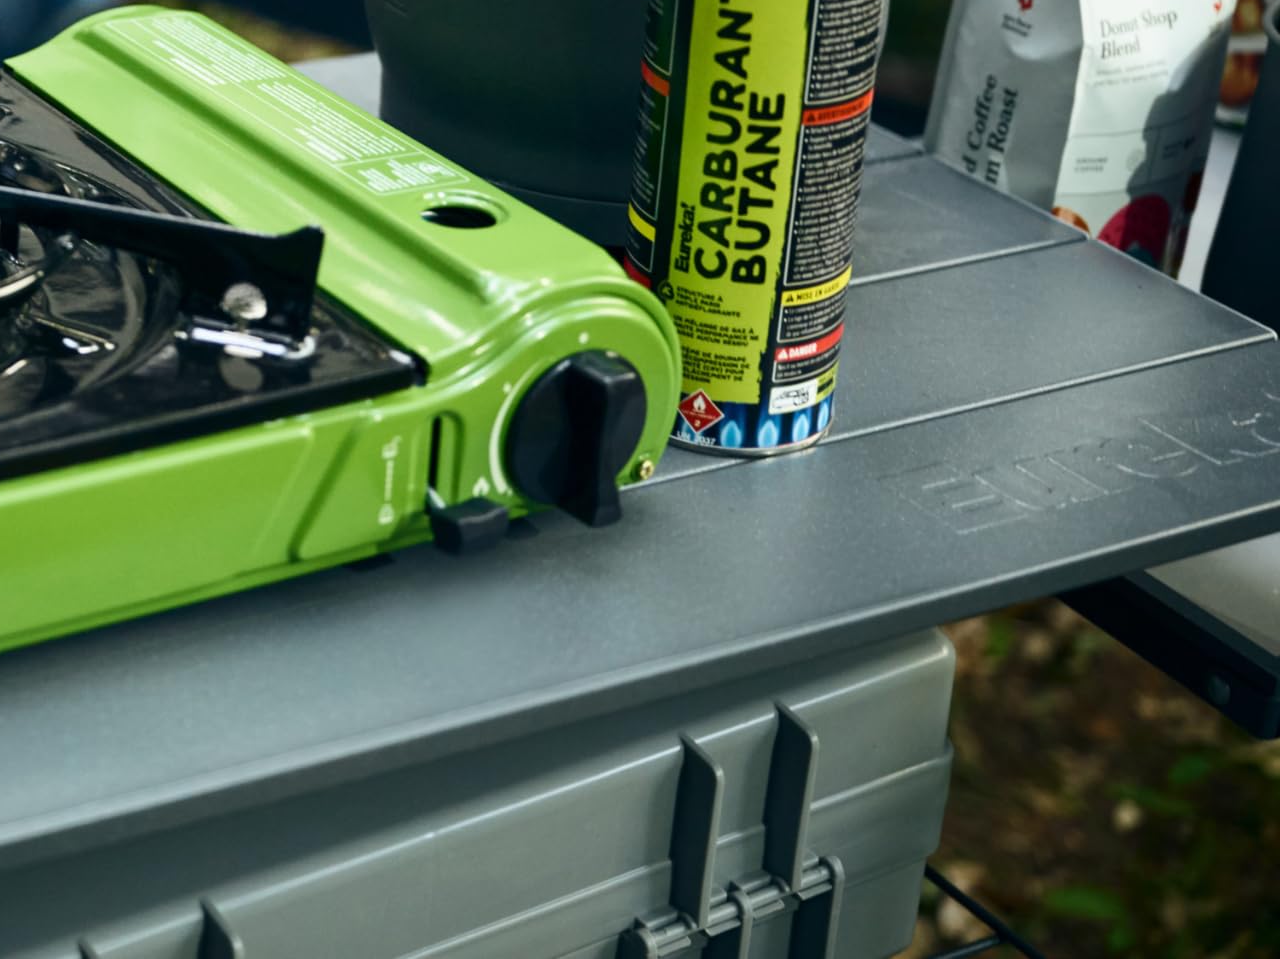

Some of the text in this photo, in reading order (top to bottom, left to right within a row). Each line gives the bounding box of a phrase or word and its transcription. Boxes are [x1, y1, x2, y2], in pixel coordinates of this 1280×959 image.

[1101, 35, 1140, 60] Blend
[1141, 9, 1177, 30] Shop
[966, 74, 997, 151] Coffee
[986, 87, 1018, 153] Roast
[730, 91, 786, 285] BUTANE
[673, 201, 696, 275] Eureka!
